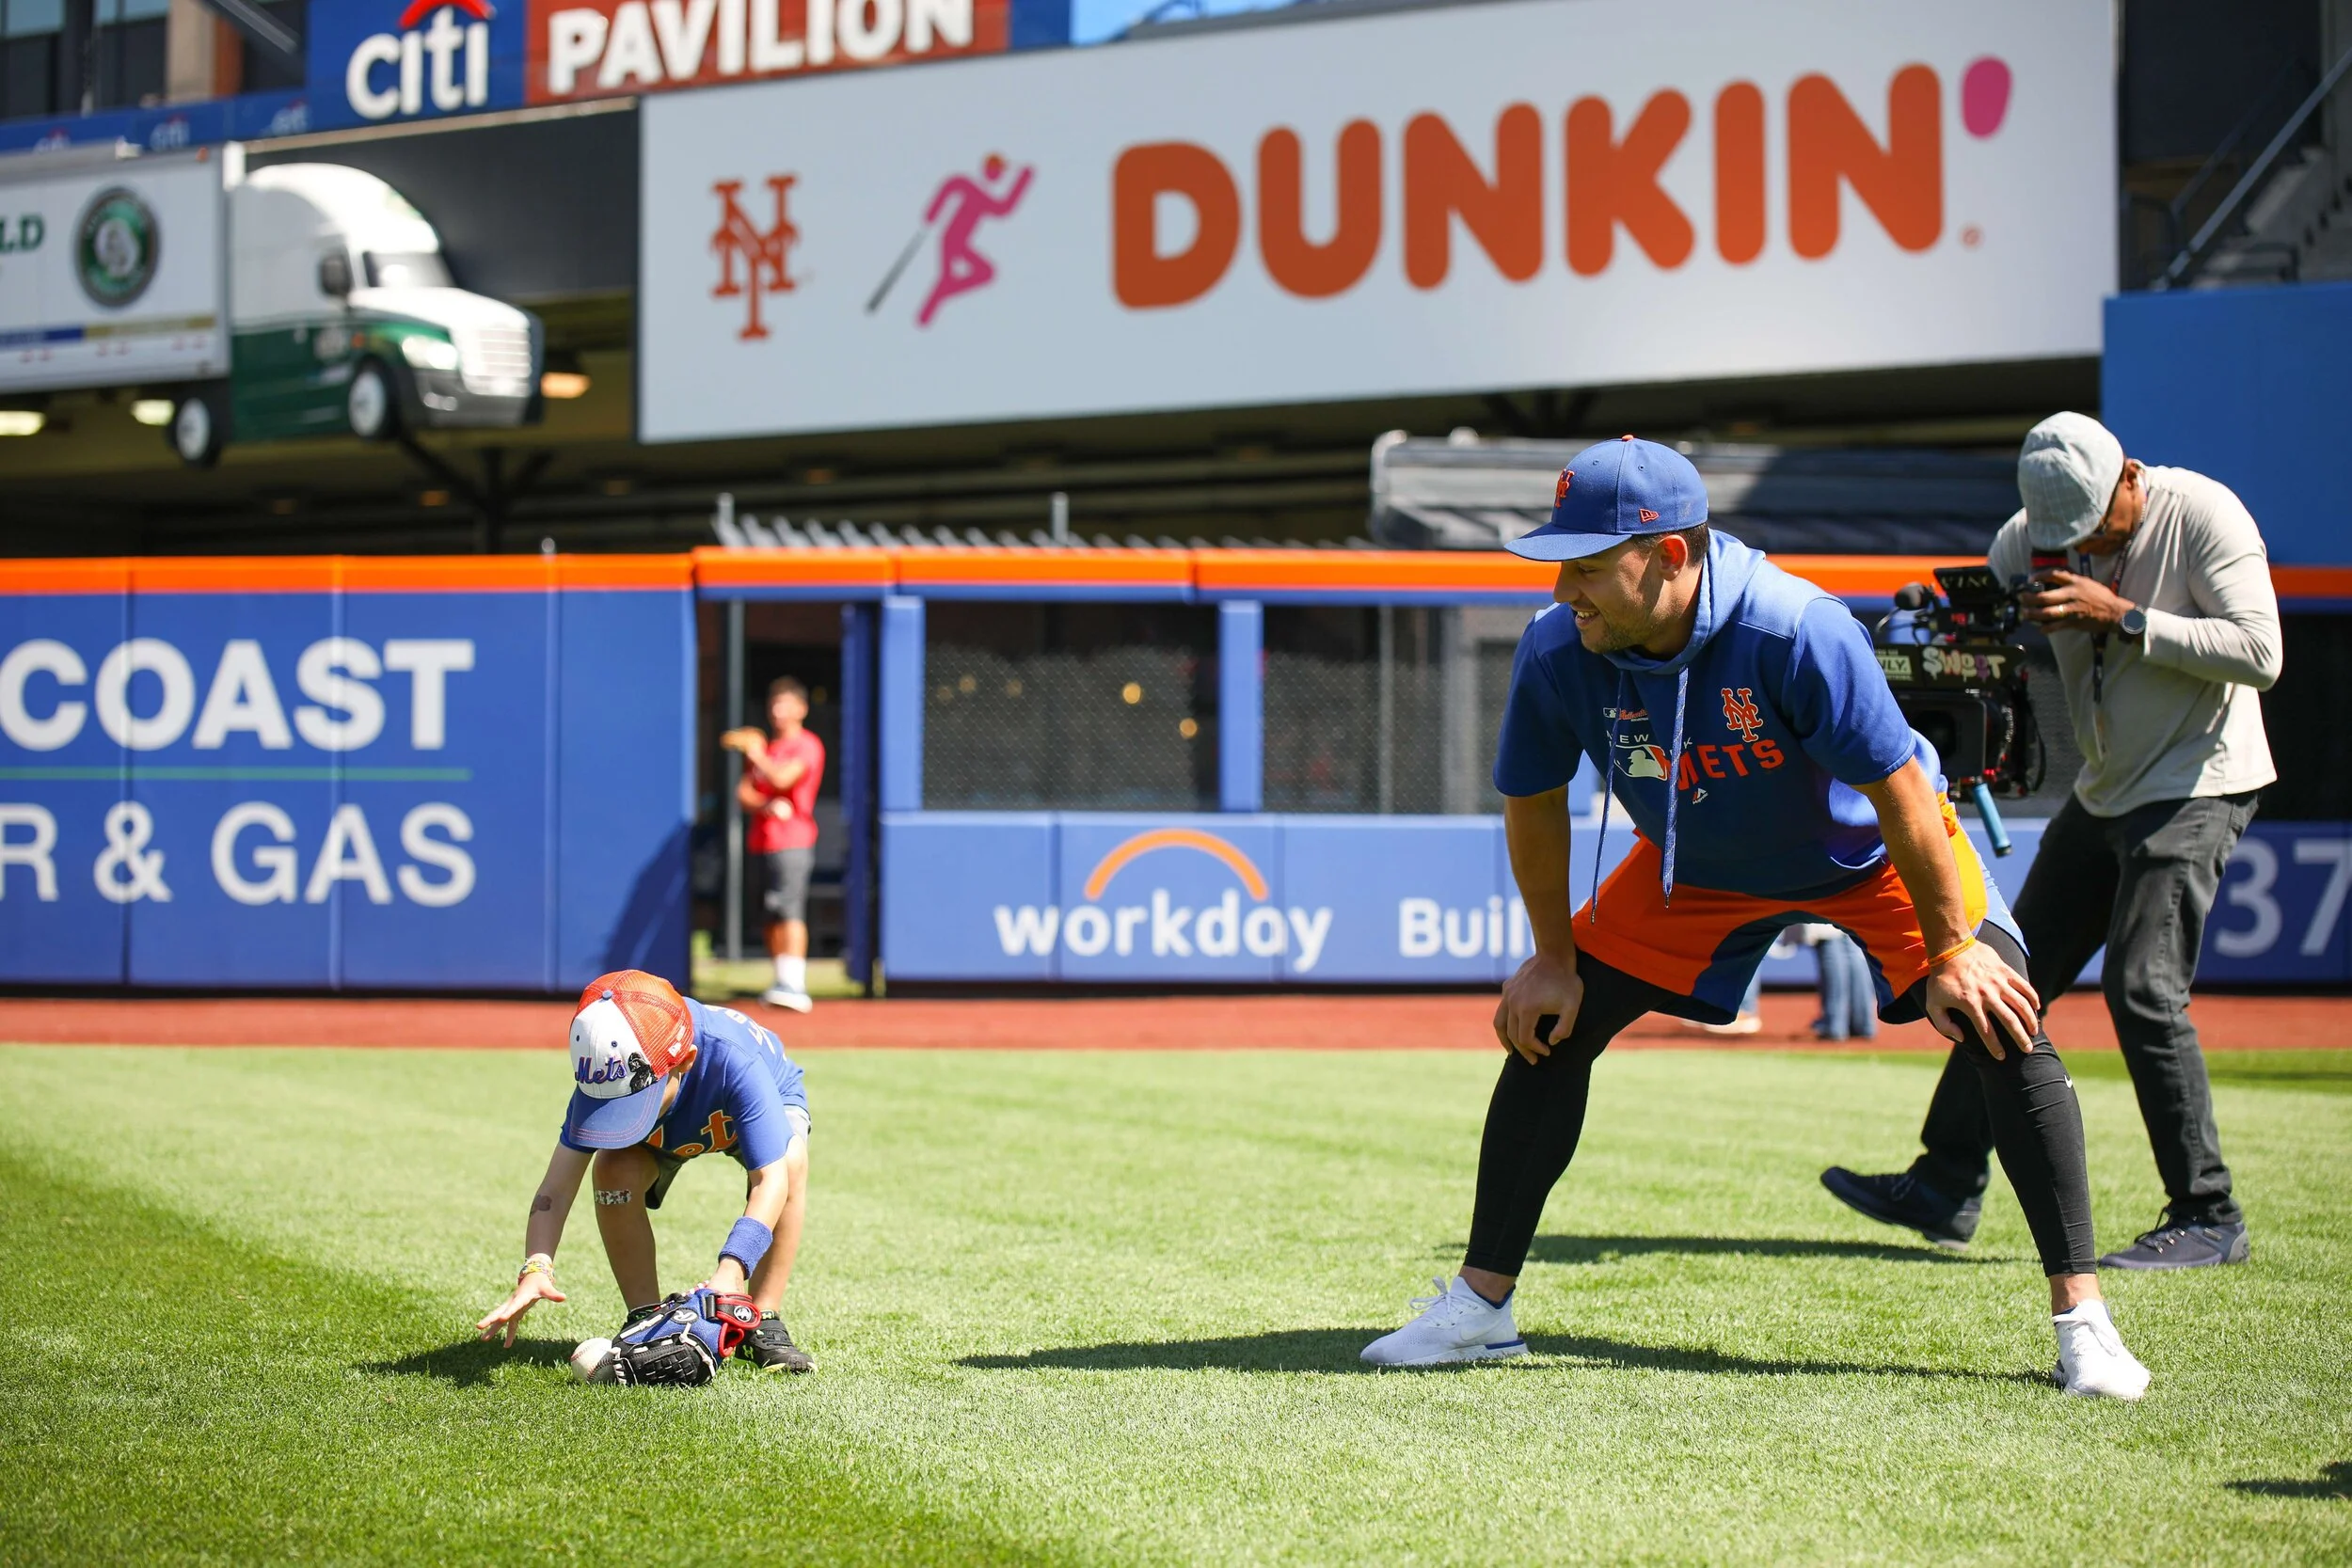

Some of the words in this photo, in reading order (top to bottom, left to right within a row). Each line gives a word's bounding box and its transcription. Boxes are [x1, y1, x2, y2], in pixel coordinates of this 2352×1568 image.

[345, 4, 489, 119] citi
[549, 0, 974, 92] PAVILION
[1111, 56, 2011, 311] DUNKIN'
[0, 637, 475, 751] COAST
[94, 801, 172, 904] &
[212, 802, 476, 908] GAS
[993, 889, 1334, 973] workday
[1399, 895, 1537, 959] Buil
[575, 1055, 628, 1085] Mets
